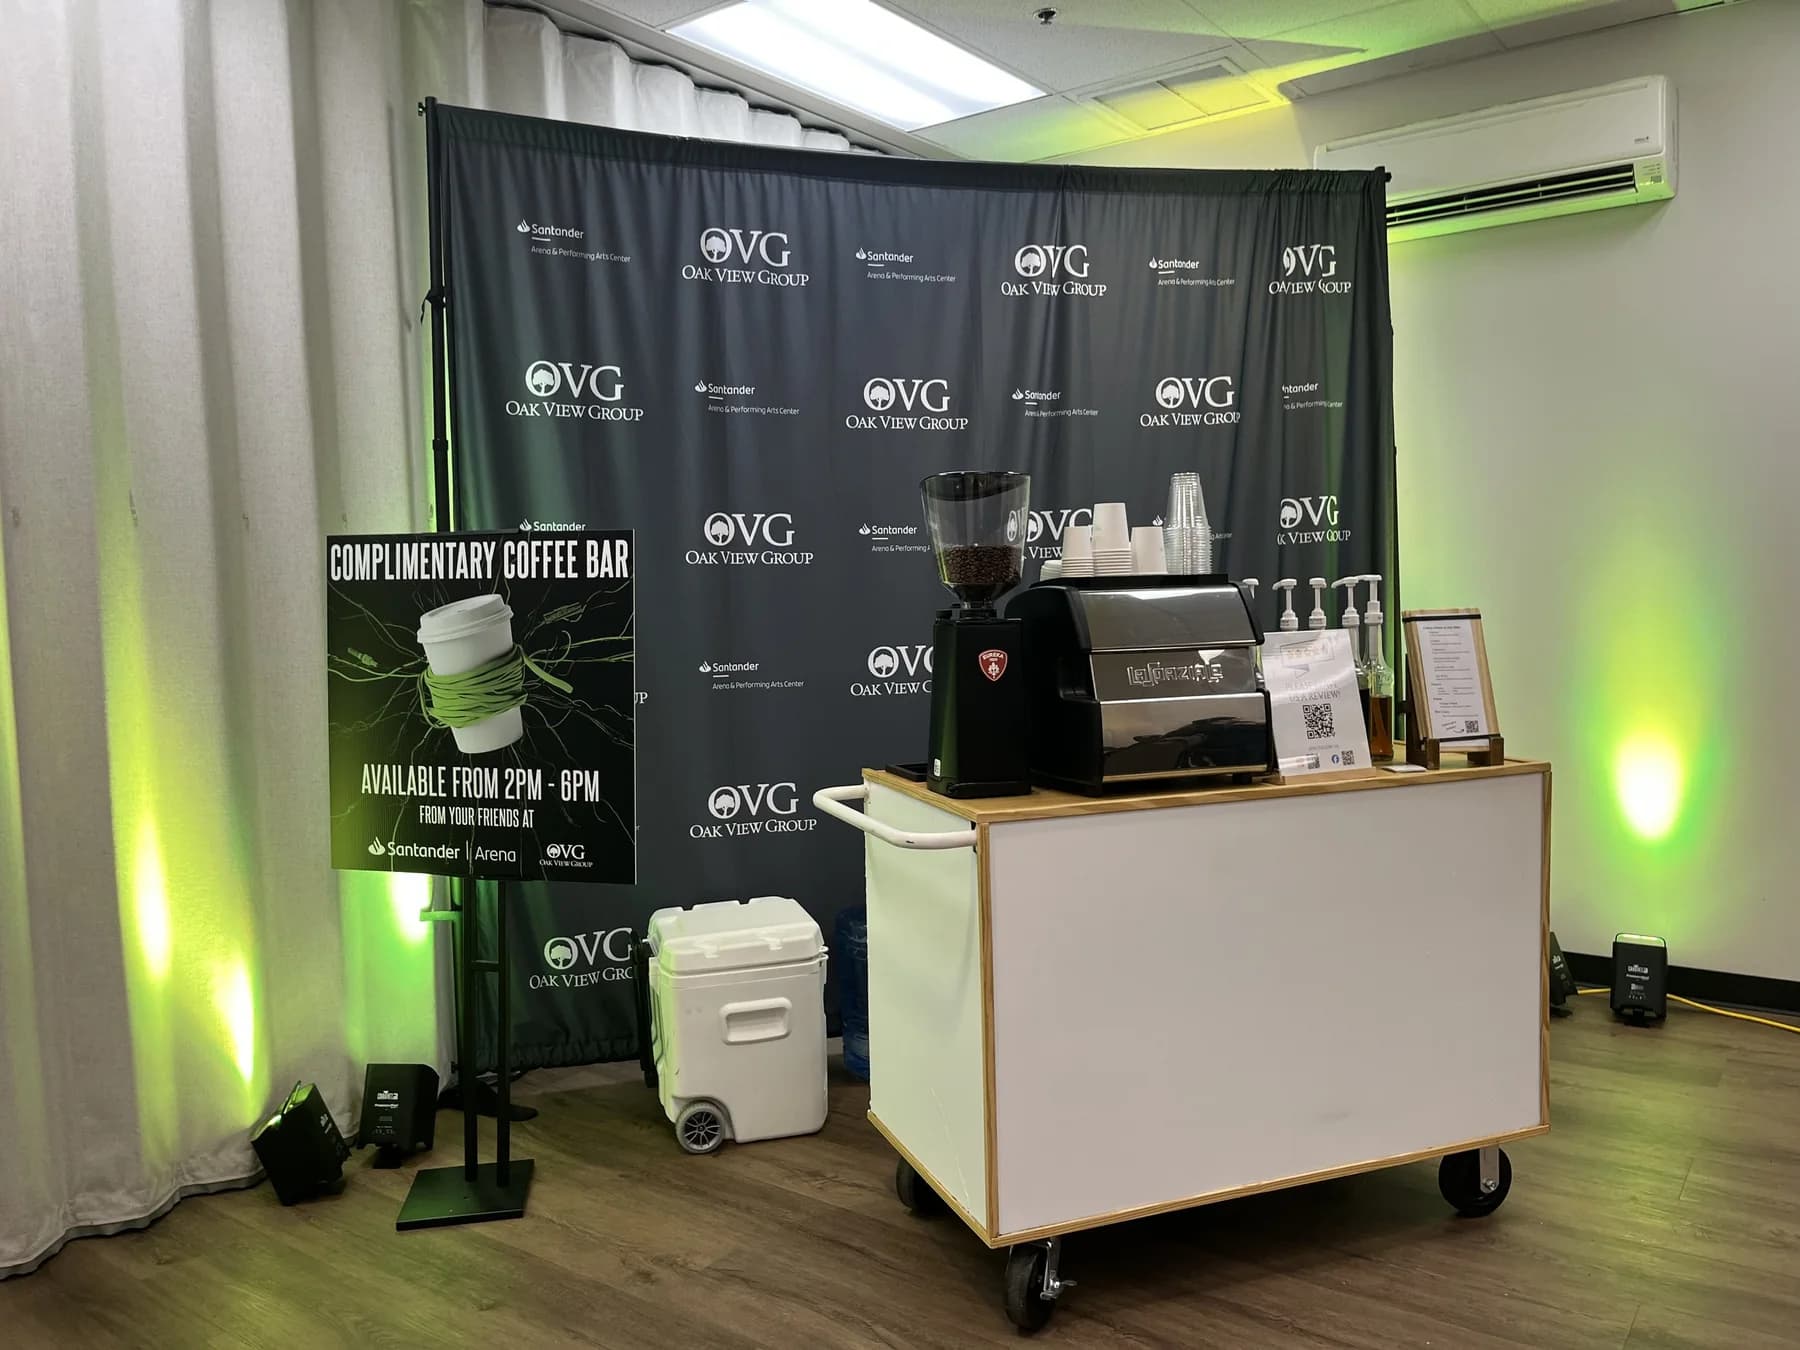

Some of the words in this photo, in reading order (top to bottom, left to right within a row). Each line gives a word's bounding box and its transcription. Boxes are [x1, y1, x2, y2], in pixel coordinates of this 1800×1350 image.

[531, 224, 584, 239] Santander
[531, 246, 551, 255] Arena
[552, 248, 558, 256] &
[558, 248, 595, 261] Performing
[596, 252, 609, 261] Arts
[610, 253, 631, 262] Center
[700, 227, 791, 267] OVG
[867, 251, 914, 263] Santander
[1014, 244, 1089, 278] OVG
[682, 265, 712, 281] OAK
[715, 268, 756, 283] VIEW
[758, 270, 809, 287] GROUP
[867, 272, 885, 280] Arena
[885, 272, 891, 280] &
[892, 272, 924, 283] Performing
[924, 274, 936, 282] Arts
[1158, 278, 1175, 286] Arena
[1001, 281, 1029, 296] OAK
[1063, 281, 1107, 296] GROUP
[525, 360, 625, 401] OVG
[708, 383, 756, 395] Santander
[863, 377, 951, 412] OVG
[1155, 376, 1235, 408] OVG
[505, 400, 541, 416] OAK
[542, 402, 587, 418] VIEW
[588, 405, 644, 421] GROUP
[724, 405, 730, 413] &
[730, 405, 766, 415] Performing
[766, 406, 779, 415] Arts
[779, 407, 800, 415] Center
[845, 415, 878, 429] OAK
[879, 415, 918, 430] VIEW
[919, 416, 969, 431] GROUP
[1140, 413, 1169, 427] OAK
[1171, 413, 1202, 426] VIEW
[1280, 495, 1339, 529] OVG
[533, 521, 586, 532] Santander
[704, 512, 795, 547] OVG
[872, 525, 918, 535] Santander
[1288, 531, 1325, 544] VIEW
[895, 545, 927, 553] Performing
[330, 541, 497, 581] COMPLIMENTARY
[503, 540, 578, 579] COFFEE
[586, 539, 629, 579] BAR
[685, 550, 718, 565] OAK
[720, 551, 759, 565] VIEW
[761, 551, 814, 565] GROUP
[713, 662, 759, 673] Santander
[712, 682, 730, 690] Arena
[730, 681, 735, 689] &
[735, 681, 770, 690] Performing
[770, 680, 783, 688] Arts
[784, 680, 804, 688] Center
[850, 683, 881, 696] OAK
[884, 682, 920, 695] VIEW
[361, 764, 447, 798] AVAILABLE
[453, 766, 498, 799] FROM
[504, 768, 542, 801] 2PM
[560, 769, 600, 802] 6PM
[708, 782, 799, 819] OVG
[419, 805, 446, 825] FROM
[449, 806, 475, 826] YOUR
[478, 807, 519, 827] FRIENDS
[522, 809, 534, 829] AT
[690, 825, 722, 839] OAK
[725, 821, 764, 836] VIEW
[765, 819, 817, 833] GROUP
[387, 841, 460, 860] Santander
[475, 846, 516, 863] Arena
[546, 843, 585, 860] OVG
[544, 927, 632, 970] OVG
[529, 975, 559, 990] OAK
[561, 971, 601, 988] VIEW
